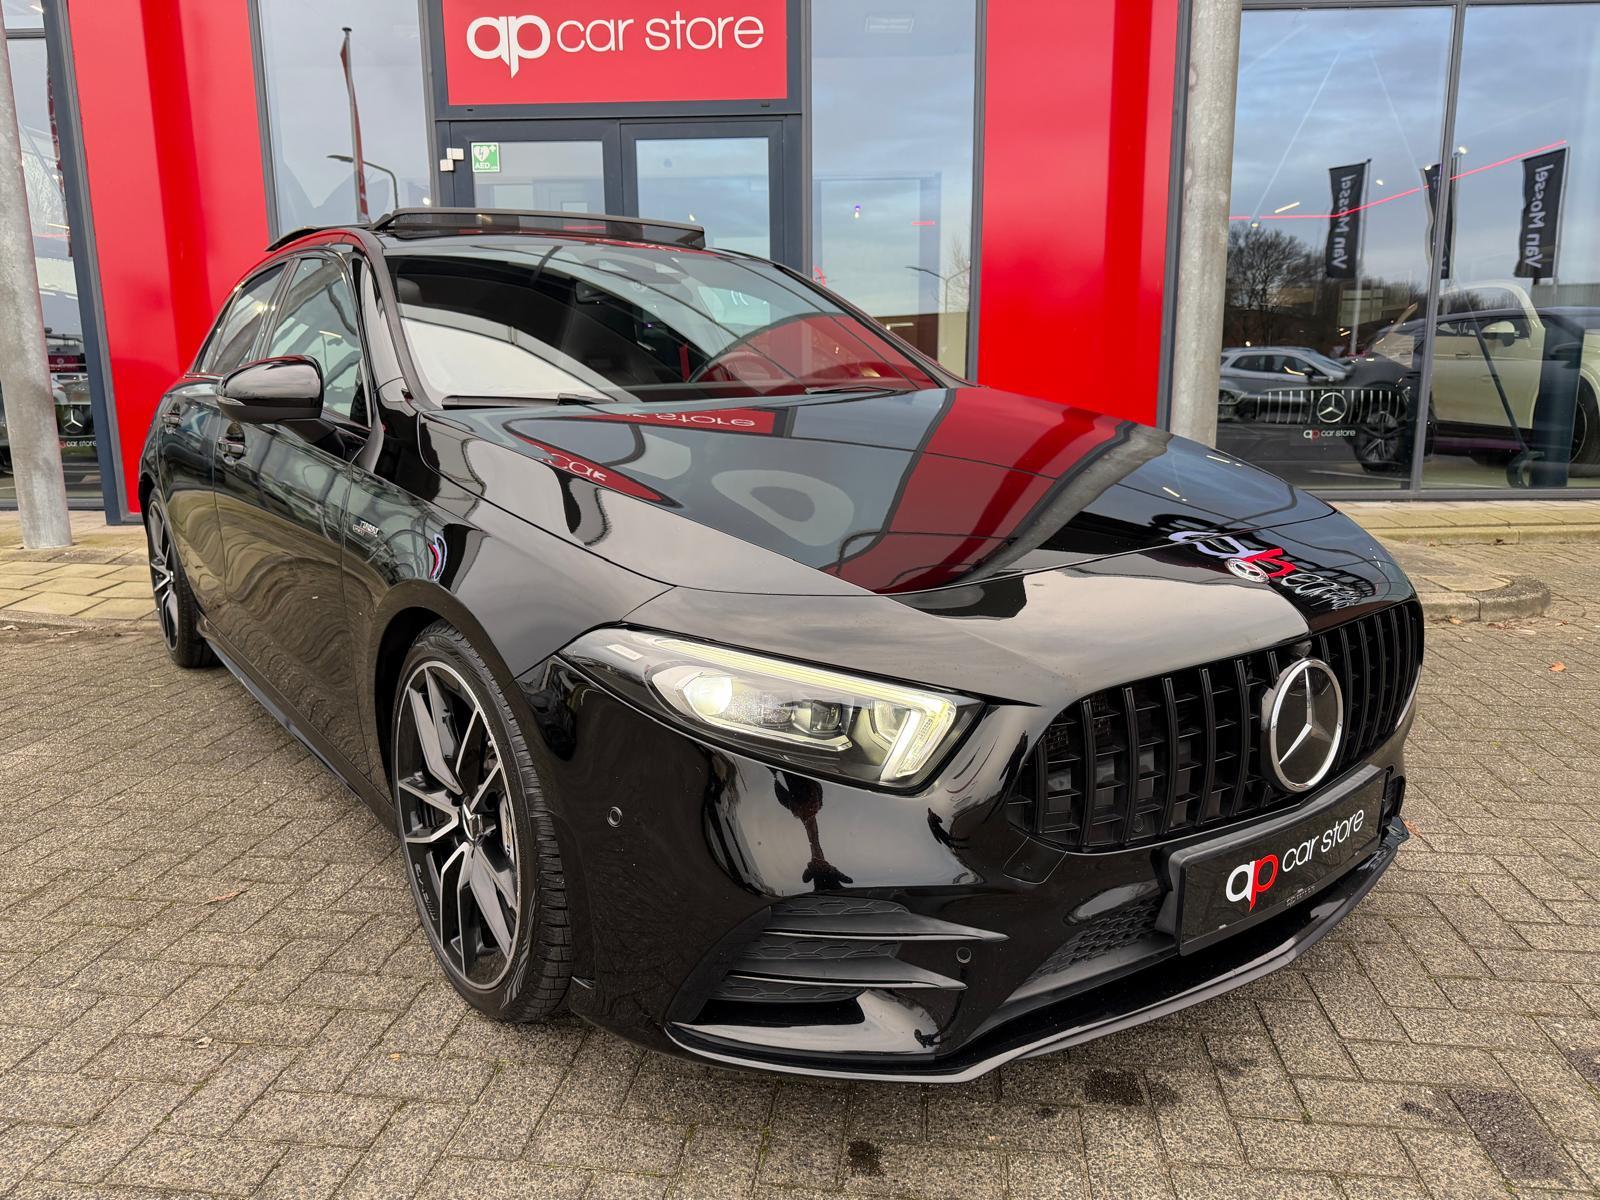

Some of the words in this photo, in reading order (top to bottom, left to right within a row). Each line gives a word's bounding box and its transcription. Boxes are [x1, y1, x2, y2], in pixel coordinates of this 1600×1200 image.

[466, 14, 551, 78] ap
[556, 18, 634, 52] car
[645, 10, 764, 50] store
[1335, 429, 1356, 437] store
[1225, 854, 1279, 912] ap
[1282, 835, 1319, 872] car
[1320, 809, 1364, 853] store
